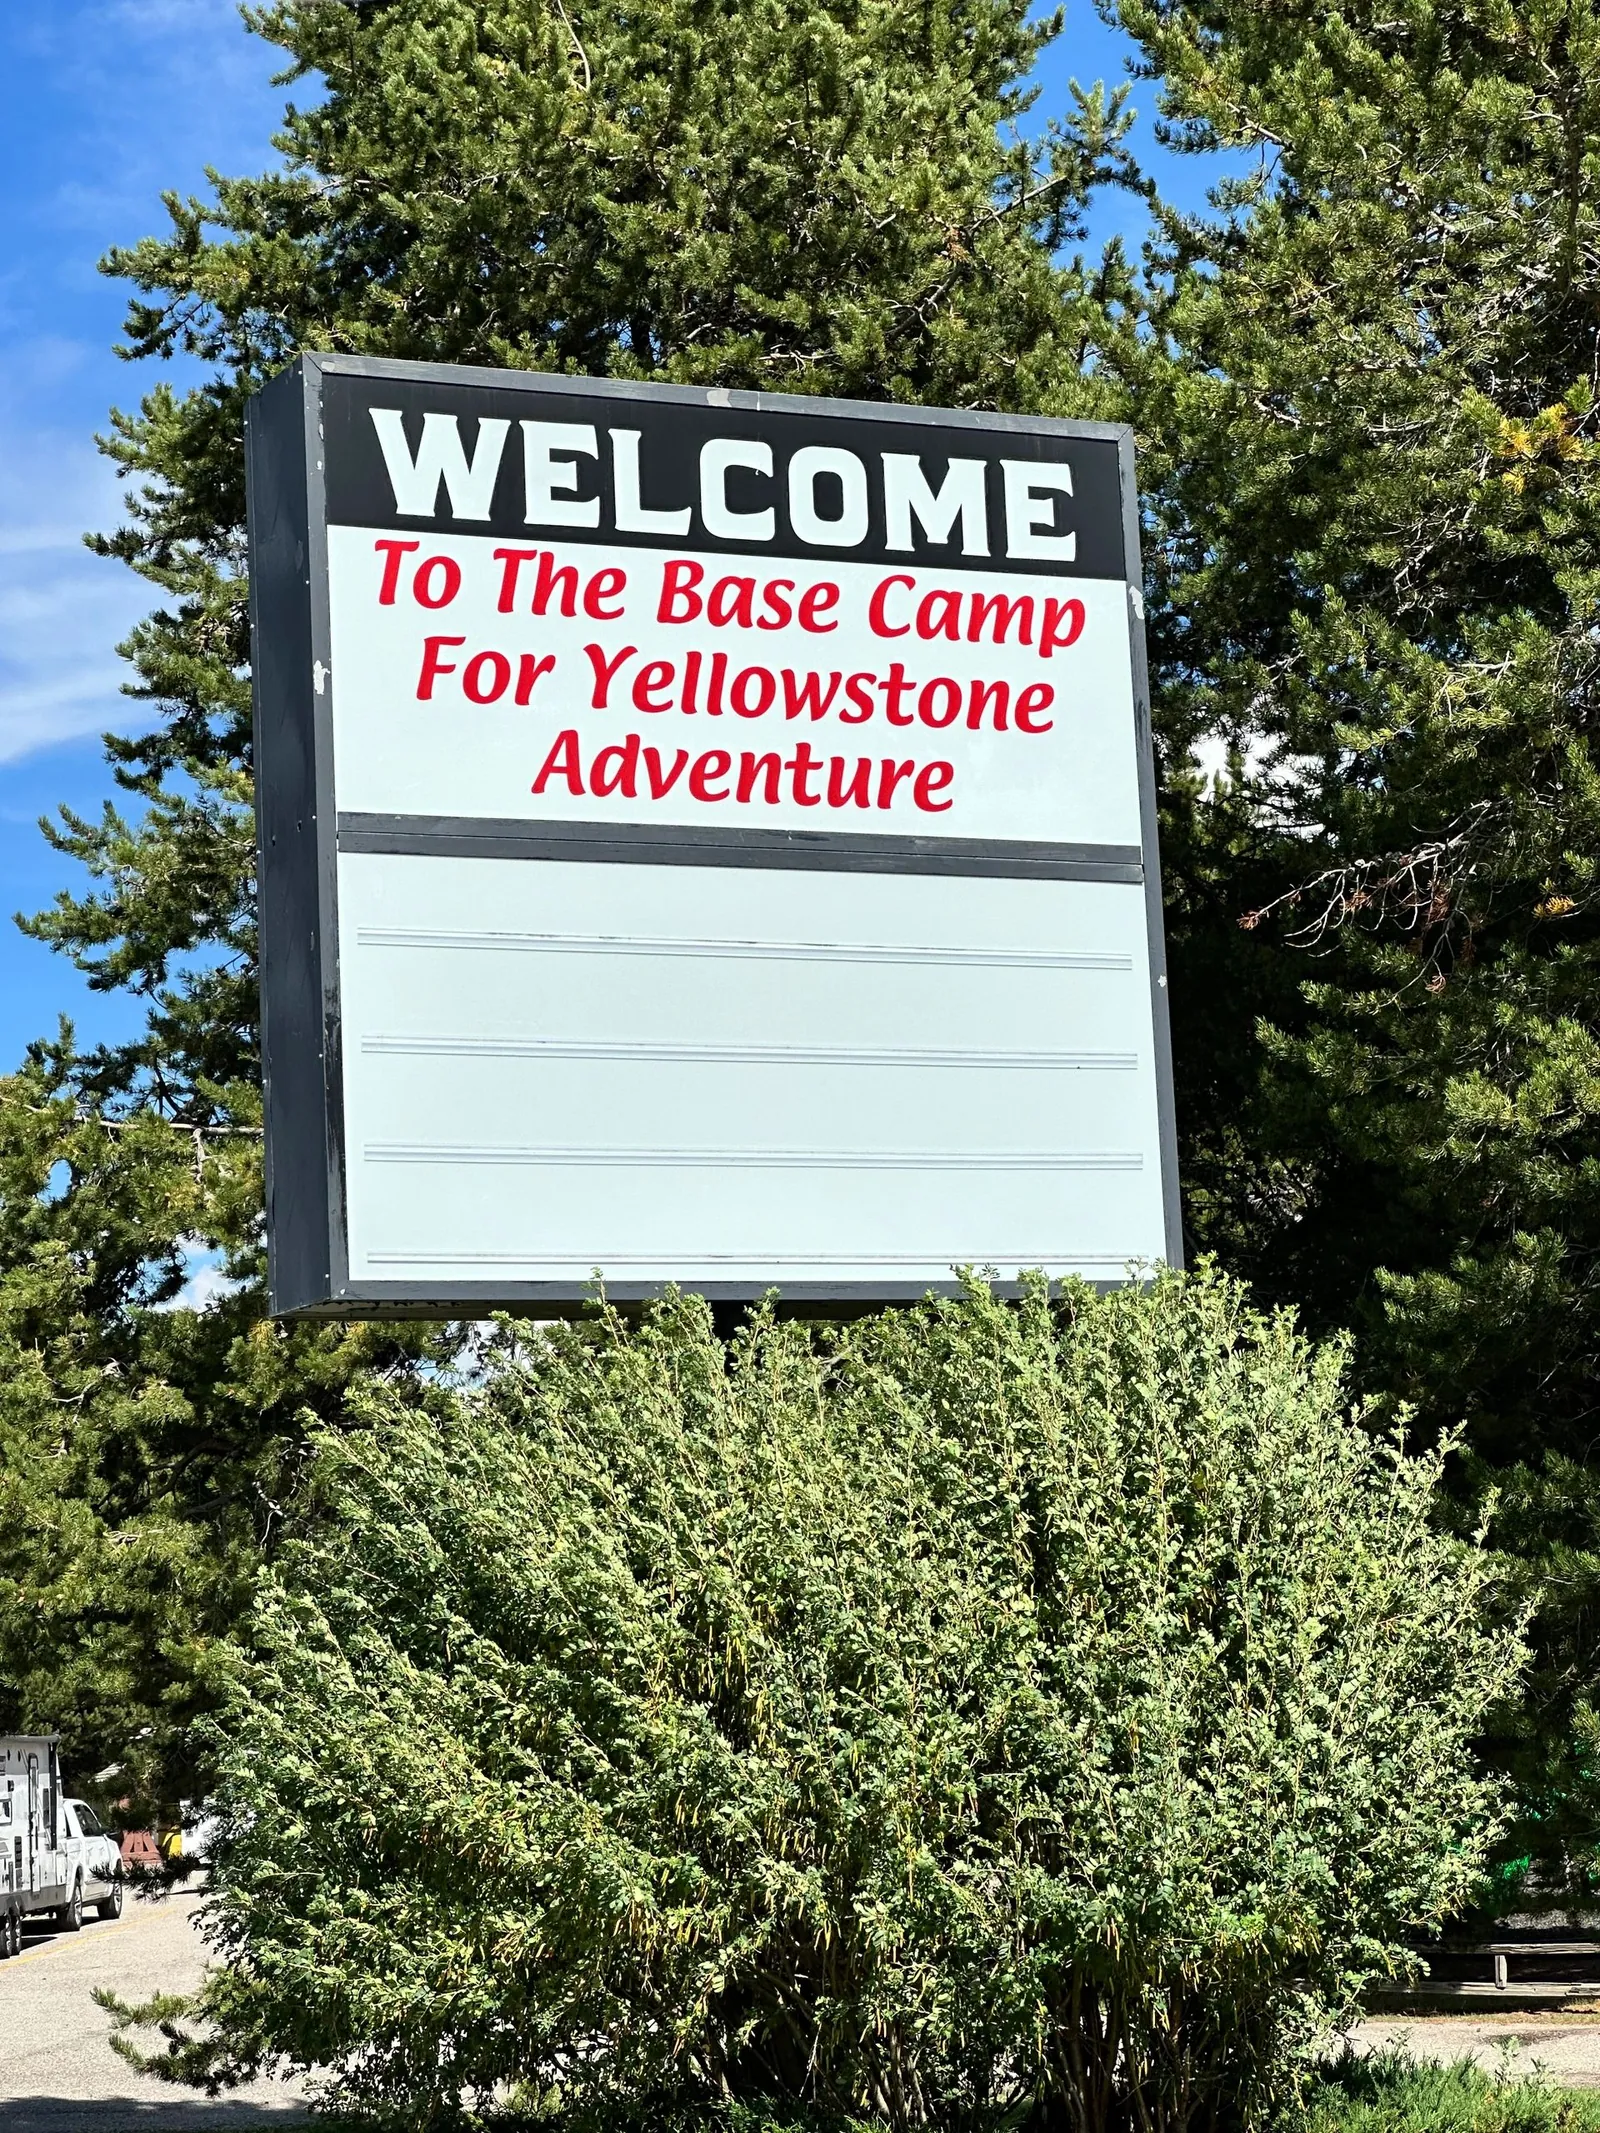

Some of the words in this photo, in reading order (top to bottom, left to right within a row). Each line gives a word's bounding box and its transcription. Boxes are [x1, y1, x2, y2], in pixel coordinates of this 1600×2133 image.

[369, 407, 1077, 563] WELCOME
[374, 539, 461, 609] To
[493, 548, 627, 621] The
[656, 559, 840, 634] Base
[868, 574, 1086, 659] Camp
[416, 636, 556, 706] For
[583, 643, 1055, 734] Yellowstone
[531, 729, 954, 813] Adventure
